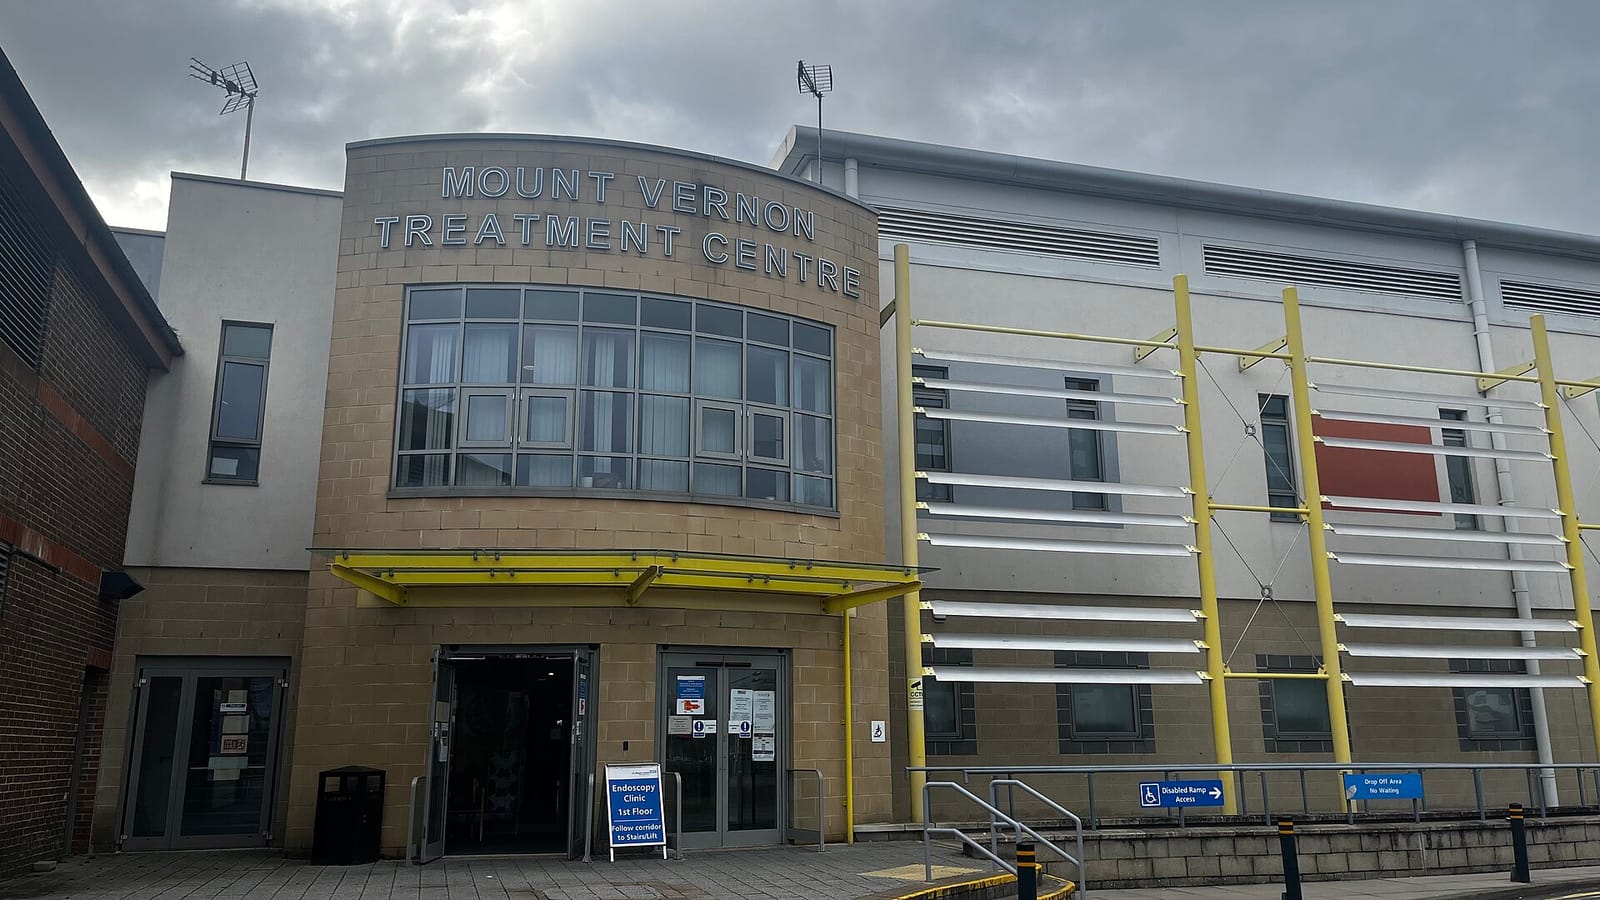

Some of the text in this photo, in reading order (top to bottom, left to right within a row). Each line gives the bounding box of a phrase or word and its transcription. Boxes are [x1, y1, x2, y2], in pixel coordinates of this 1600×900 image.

[441, 166, 816, 241] MOUNT VERNON
[374, 213, 861, 298] TREATMENT CENTRE
[1364, 778, 1378, 786] Drop
[612, 784, 656, 793] Endoscopy
[1161, 786, 1207, 795] Disabled Ramp
[1378, 787, 1400, 795] Waiting
[623, 793, 646, 803] Clinic
[1175, 795, 1196, 803] Access
[618, 807, 654, 816] 1st Floor
[635, 823, 662, 831] corridor
[626, 832, 658, 841] Stairs/Lift
